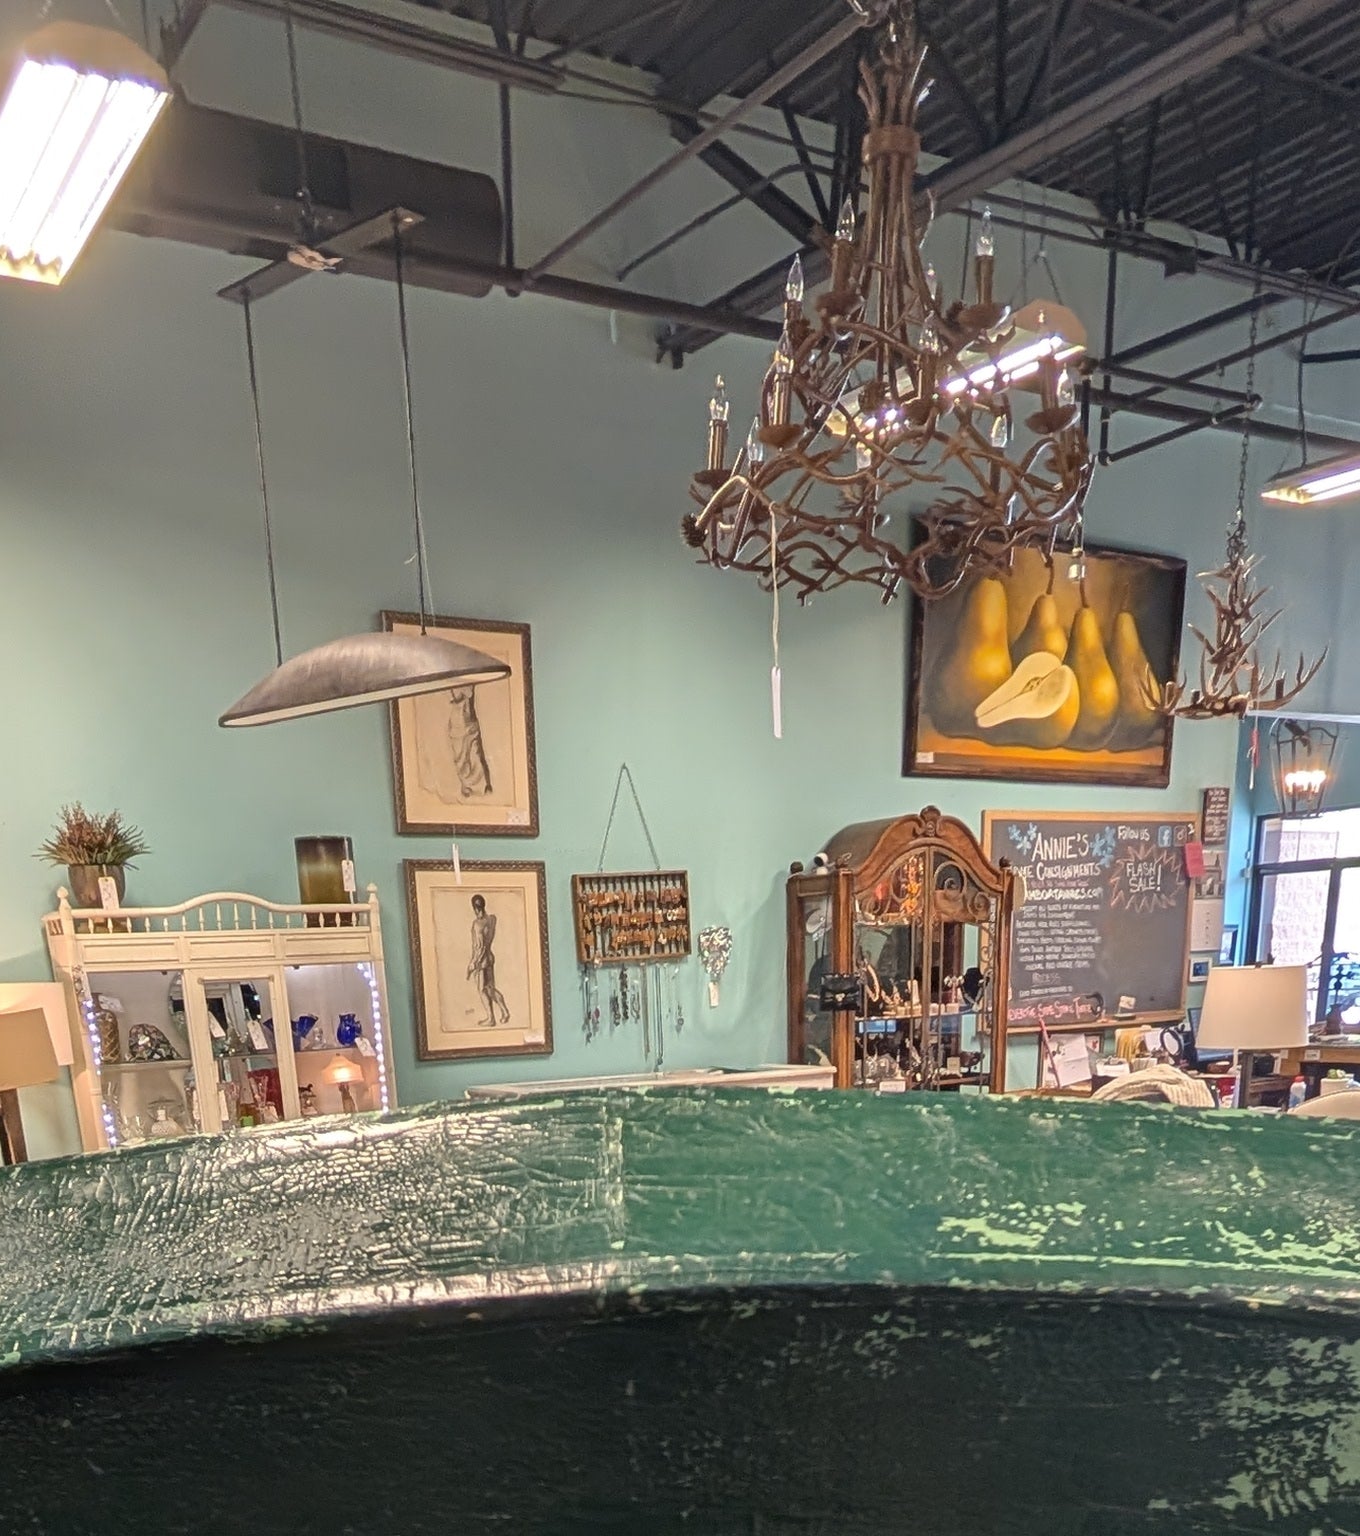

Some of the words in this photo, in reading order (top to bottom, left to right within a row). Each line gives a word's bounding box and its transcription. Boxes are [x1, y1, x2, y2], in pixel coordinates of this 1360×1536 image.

[1031, 832, 1089, 862] ANNIE'S
[1036, 861, 1101, 880] CONSIGNMENTS
[1126, 861, 1155, 877] FLASH
